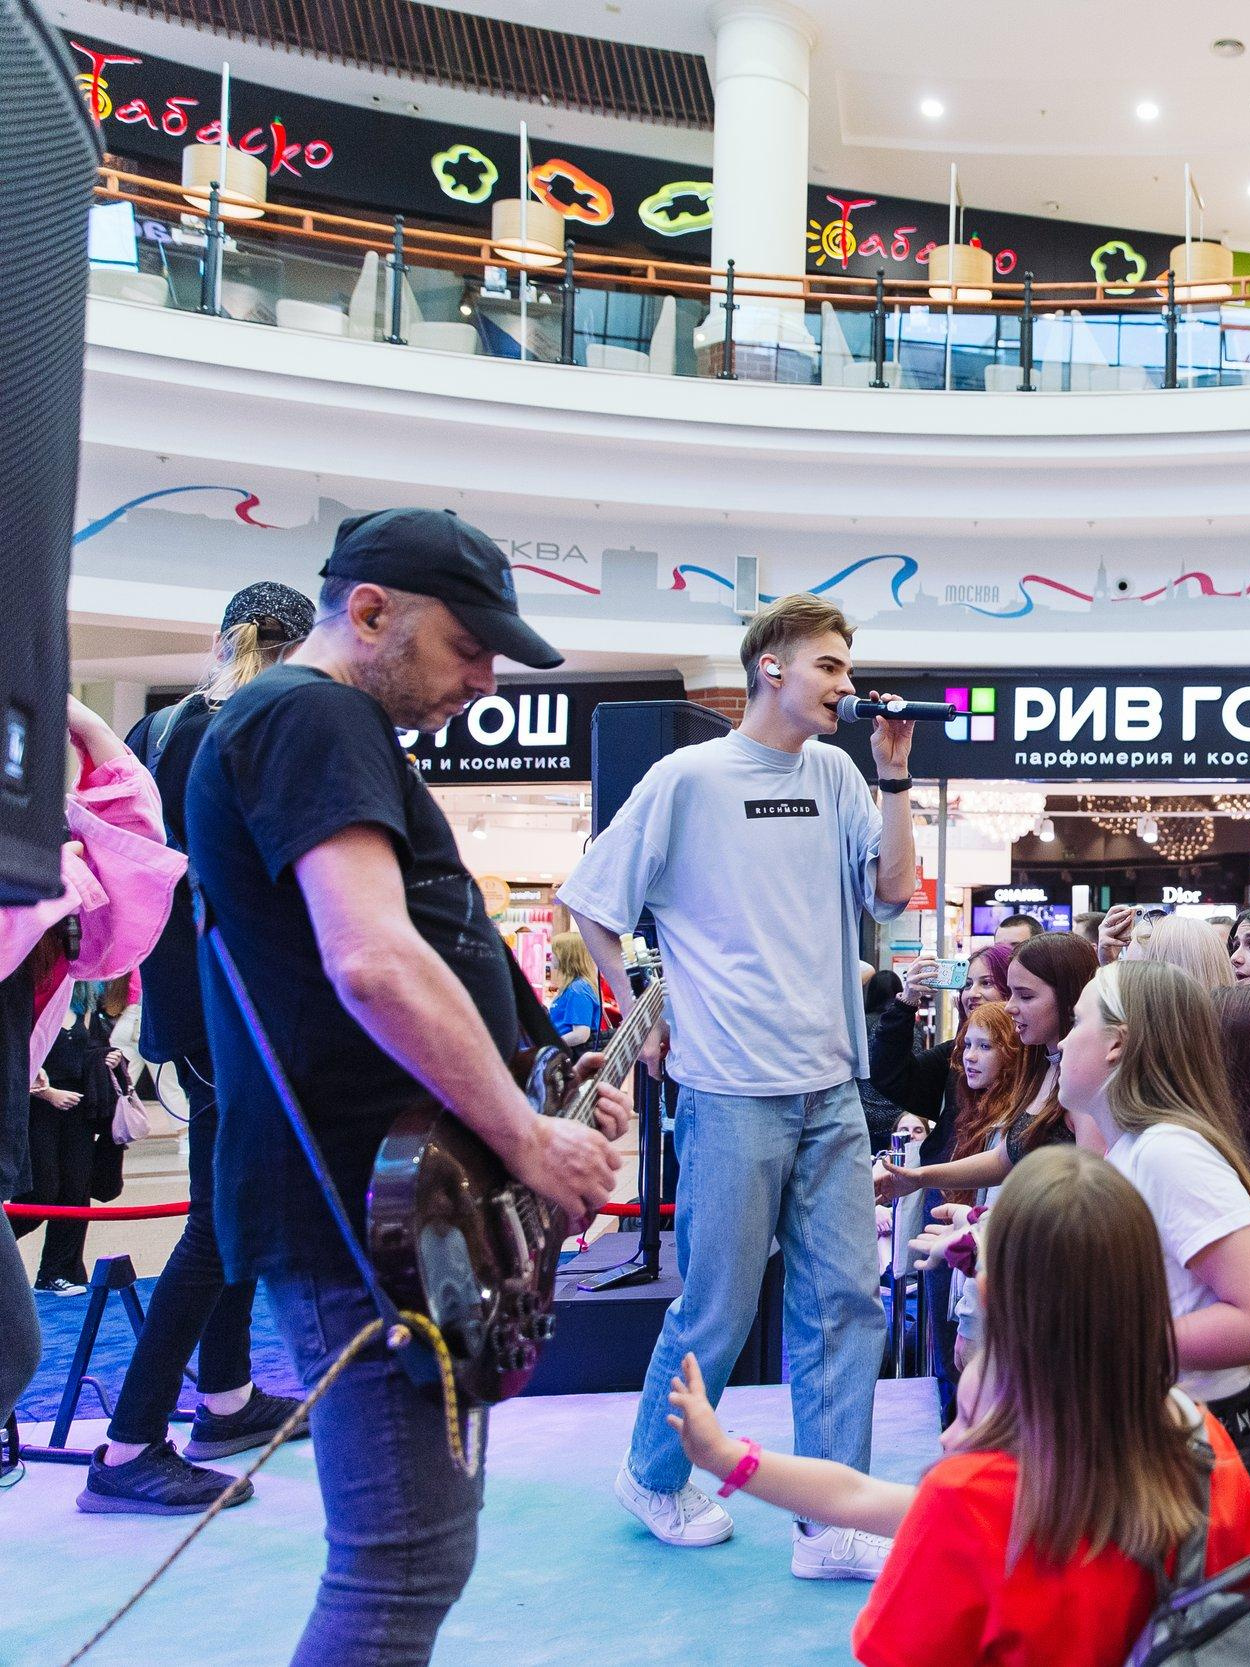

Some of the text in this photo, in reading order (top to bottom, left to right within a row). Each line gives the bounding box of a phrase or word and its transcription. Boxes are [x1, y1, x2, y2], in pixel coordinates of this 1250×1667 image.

[945, 584, 999, 603] МОСКВА
[1014, 686, 1163, 742] РИВ
[440, 759, 451, 770] и
[459, 756, 571, 770] косметика
[1015, 750, 1173, 768] парфюмерия
[1184, 752, 1196, 766] и
[1161, 886, 1202, 904] Dior
